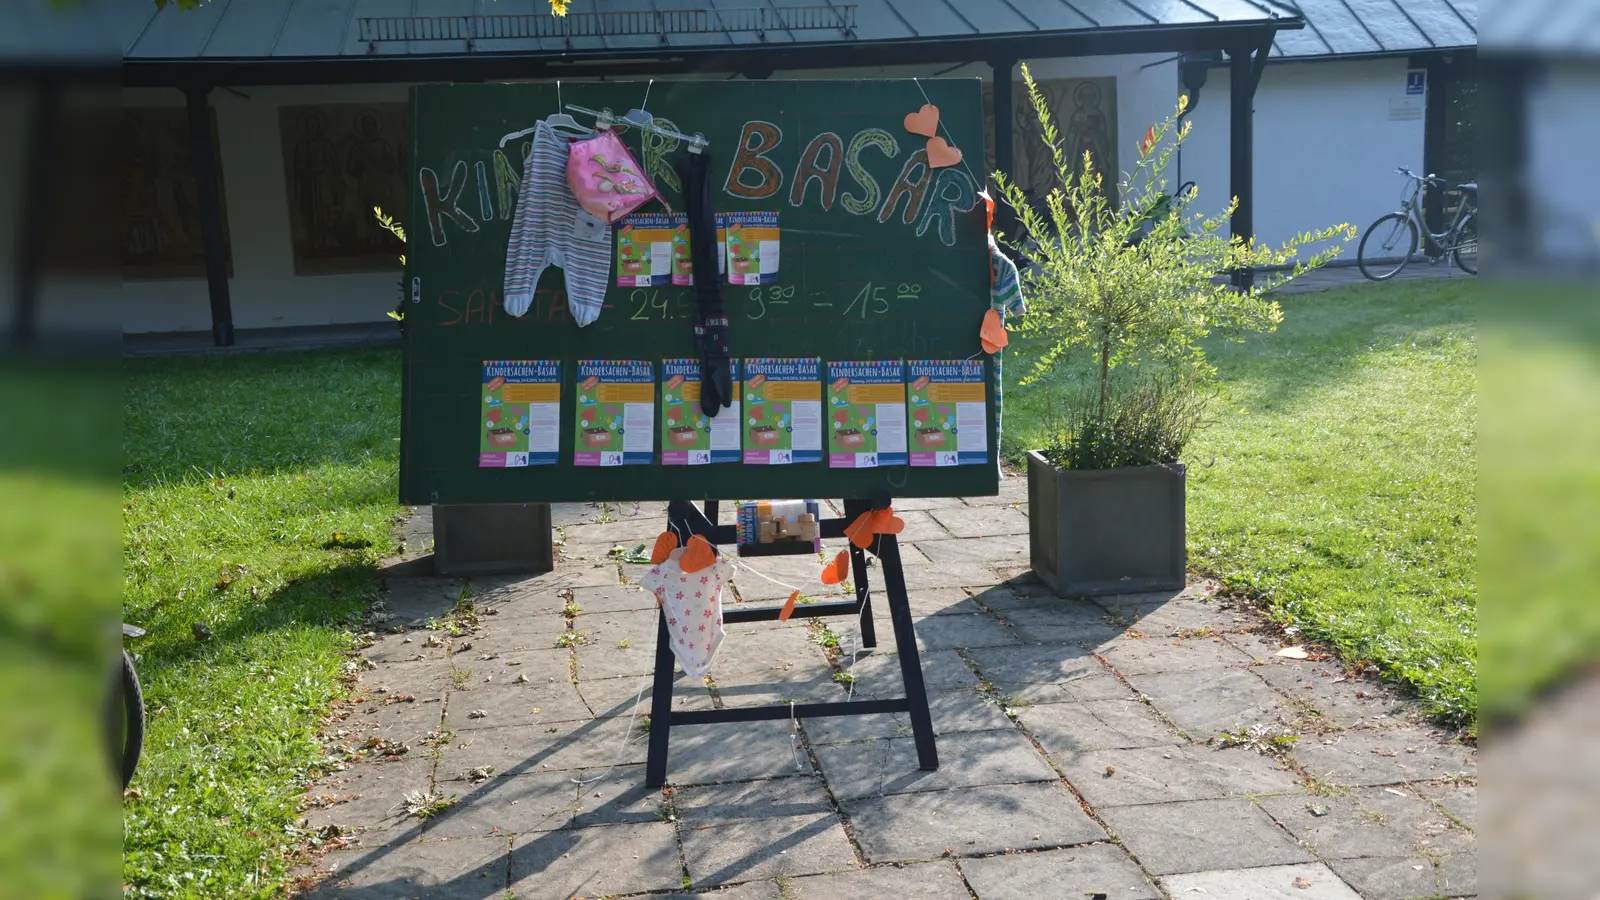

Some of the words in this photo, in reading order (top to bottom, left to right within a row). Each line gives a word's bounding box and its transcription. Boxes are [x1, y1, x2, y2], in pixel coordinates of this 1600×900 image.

[420, 118, 682, 247] KINR
[722, 121, 976, 246] BASAR
[486, 366, 557, 377] KINDERSACHEN-BASAR
[580, 366, 651, 377] KINDERSACHEN-BASAR
[747, 363, 817, 374] KINDERSACHEN-BASAR
[831, 366, 901, 377] KINDERSACHEN-BASAR
[911, 366, 981, 376] KINDERSACHEN-BASAR
